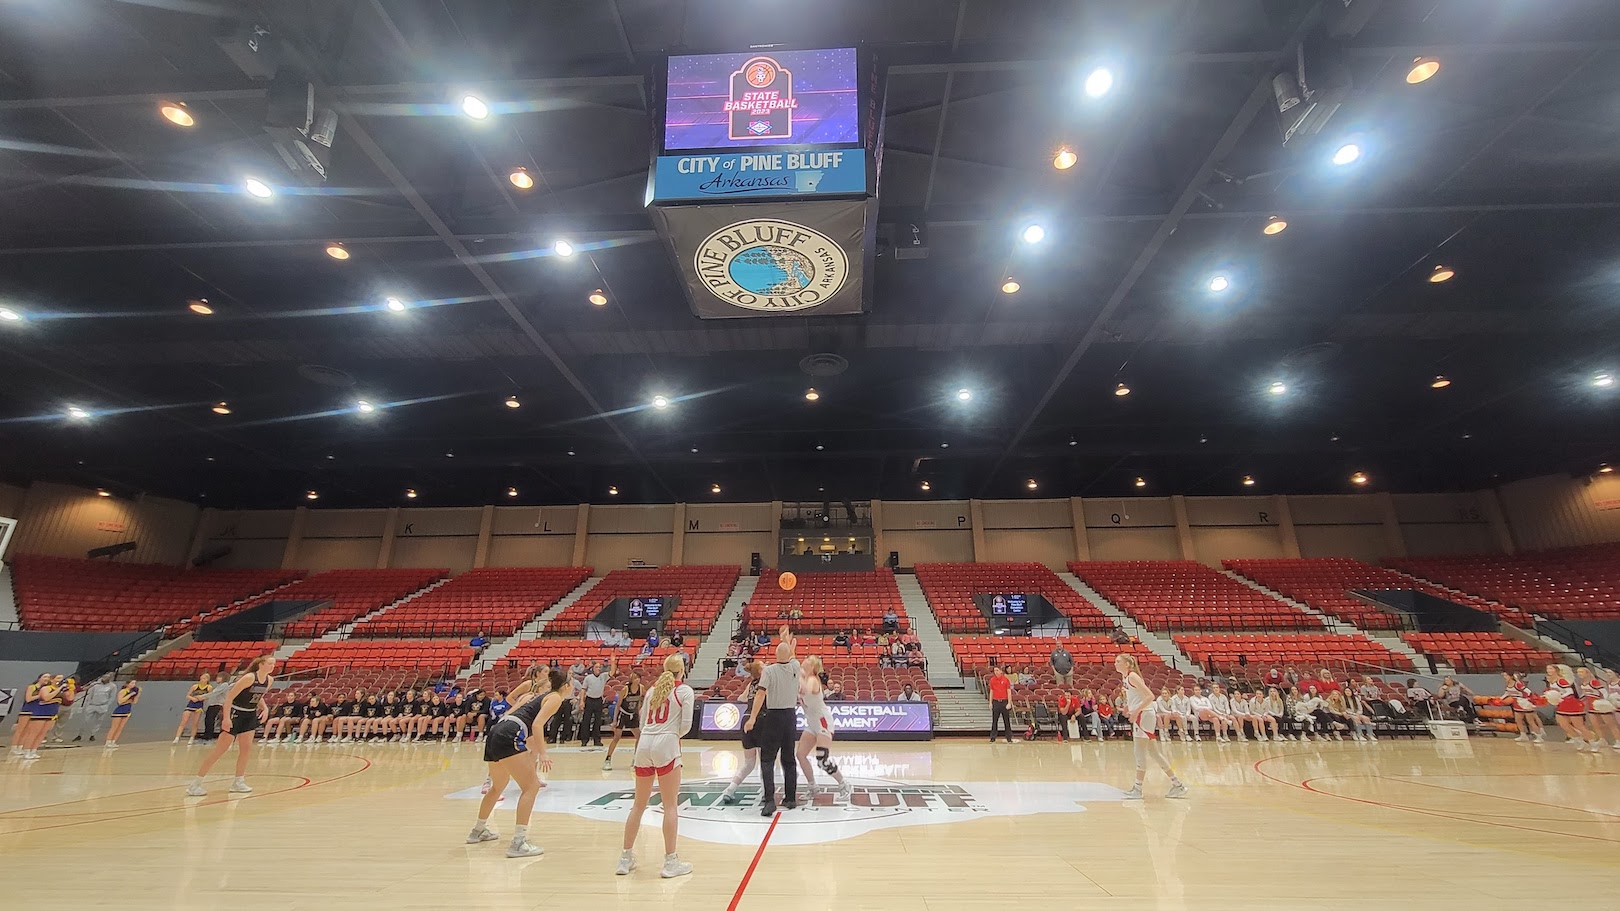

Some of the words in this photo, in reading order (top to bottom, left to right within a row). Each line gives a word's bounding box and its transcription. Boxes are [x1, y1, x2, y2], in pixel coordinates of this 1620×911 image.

[744, 91, 779, 100] STATE
[726, 99, 798, 110] BASKETBALL
[677, 156, 720, 174] CITY
[723, 159, 736, 170] of
[740, 154, 783, 172] PINE
[787, 152, 843, 170] BLUFF
[699, 171, 791, 190] Arkansas
[716, 225, 812, 252] BLUFF
[701, 248, 731, 289] PINE
[814, 247, 836, 289] ARKANSAS
[722, 289, 758, 305] OF
[763, 289, 820, 308] CITY
[957, 515, 966, 527] P
[1111, 513, 1121, 524] Q
[1258, 511, 1269, 523] R
[404, 523, 414, 534] K
[543, 521, 552, 532] L
[689, 519, 699, 530] M
[647, 699, 671, 725] 10
